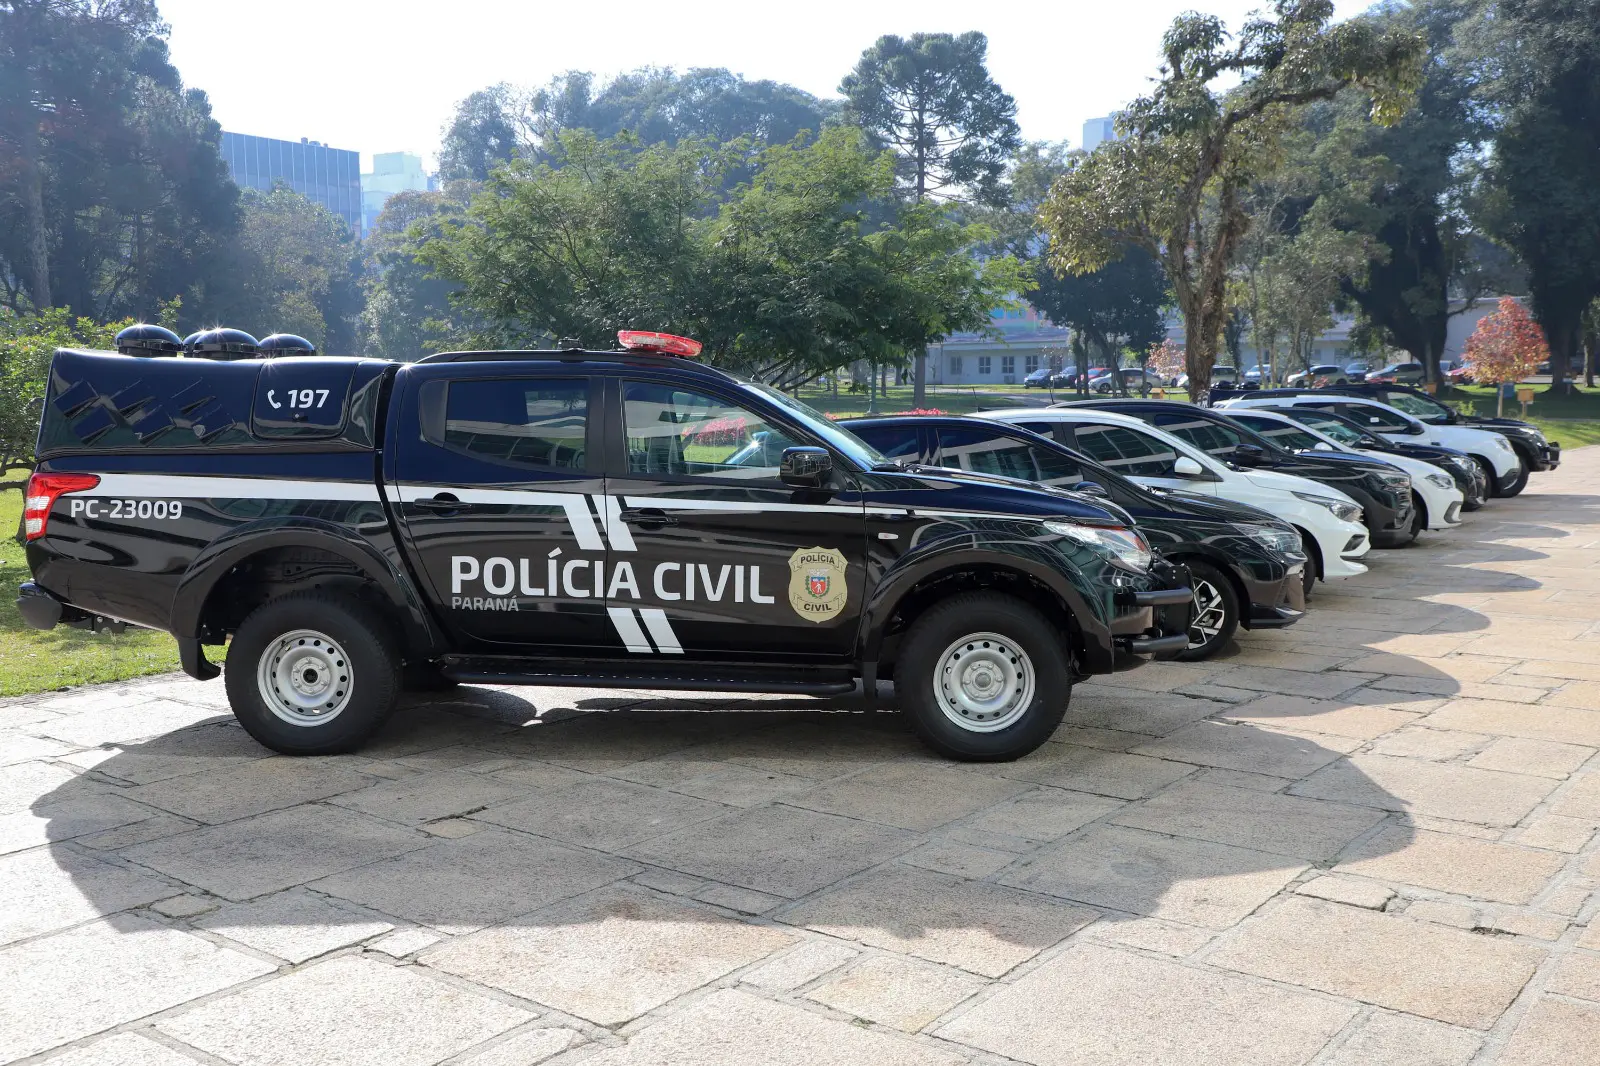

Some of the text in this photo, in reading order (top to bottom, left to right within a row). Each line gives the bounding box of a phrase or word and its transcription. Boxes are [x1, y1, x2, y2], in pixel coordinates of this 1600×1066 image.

[287, 389, 330, 408] 197
[70, 499, 183, 520] PC-23009
[800, 554, 835, 564] POLÍCIA
[451, 547, 775, 604] POLÍCIA CIVIL
[451, 595, 520, 612] PARANÁ
[803, 603, 832, 611] CIVIL
